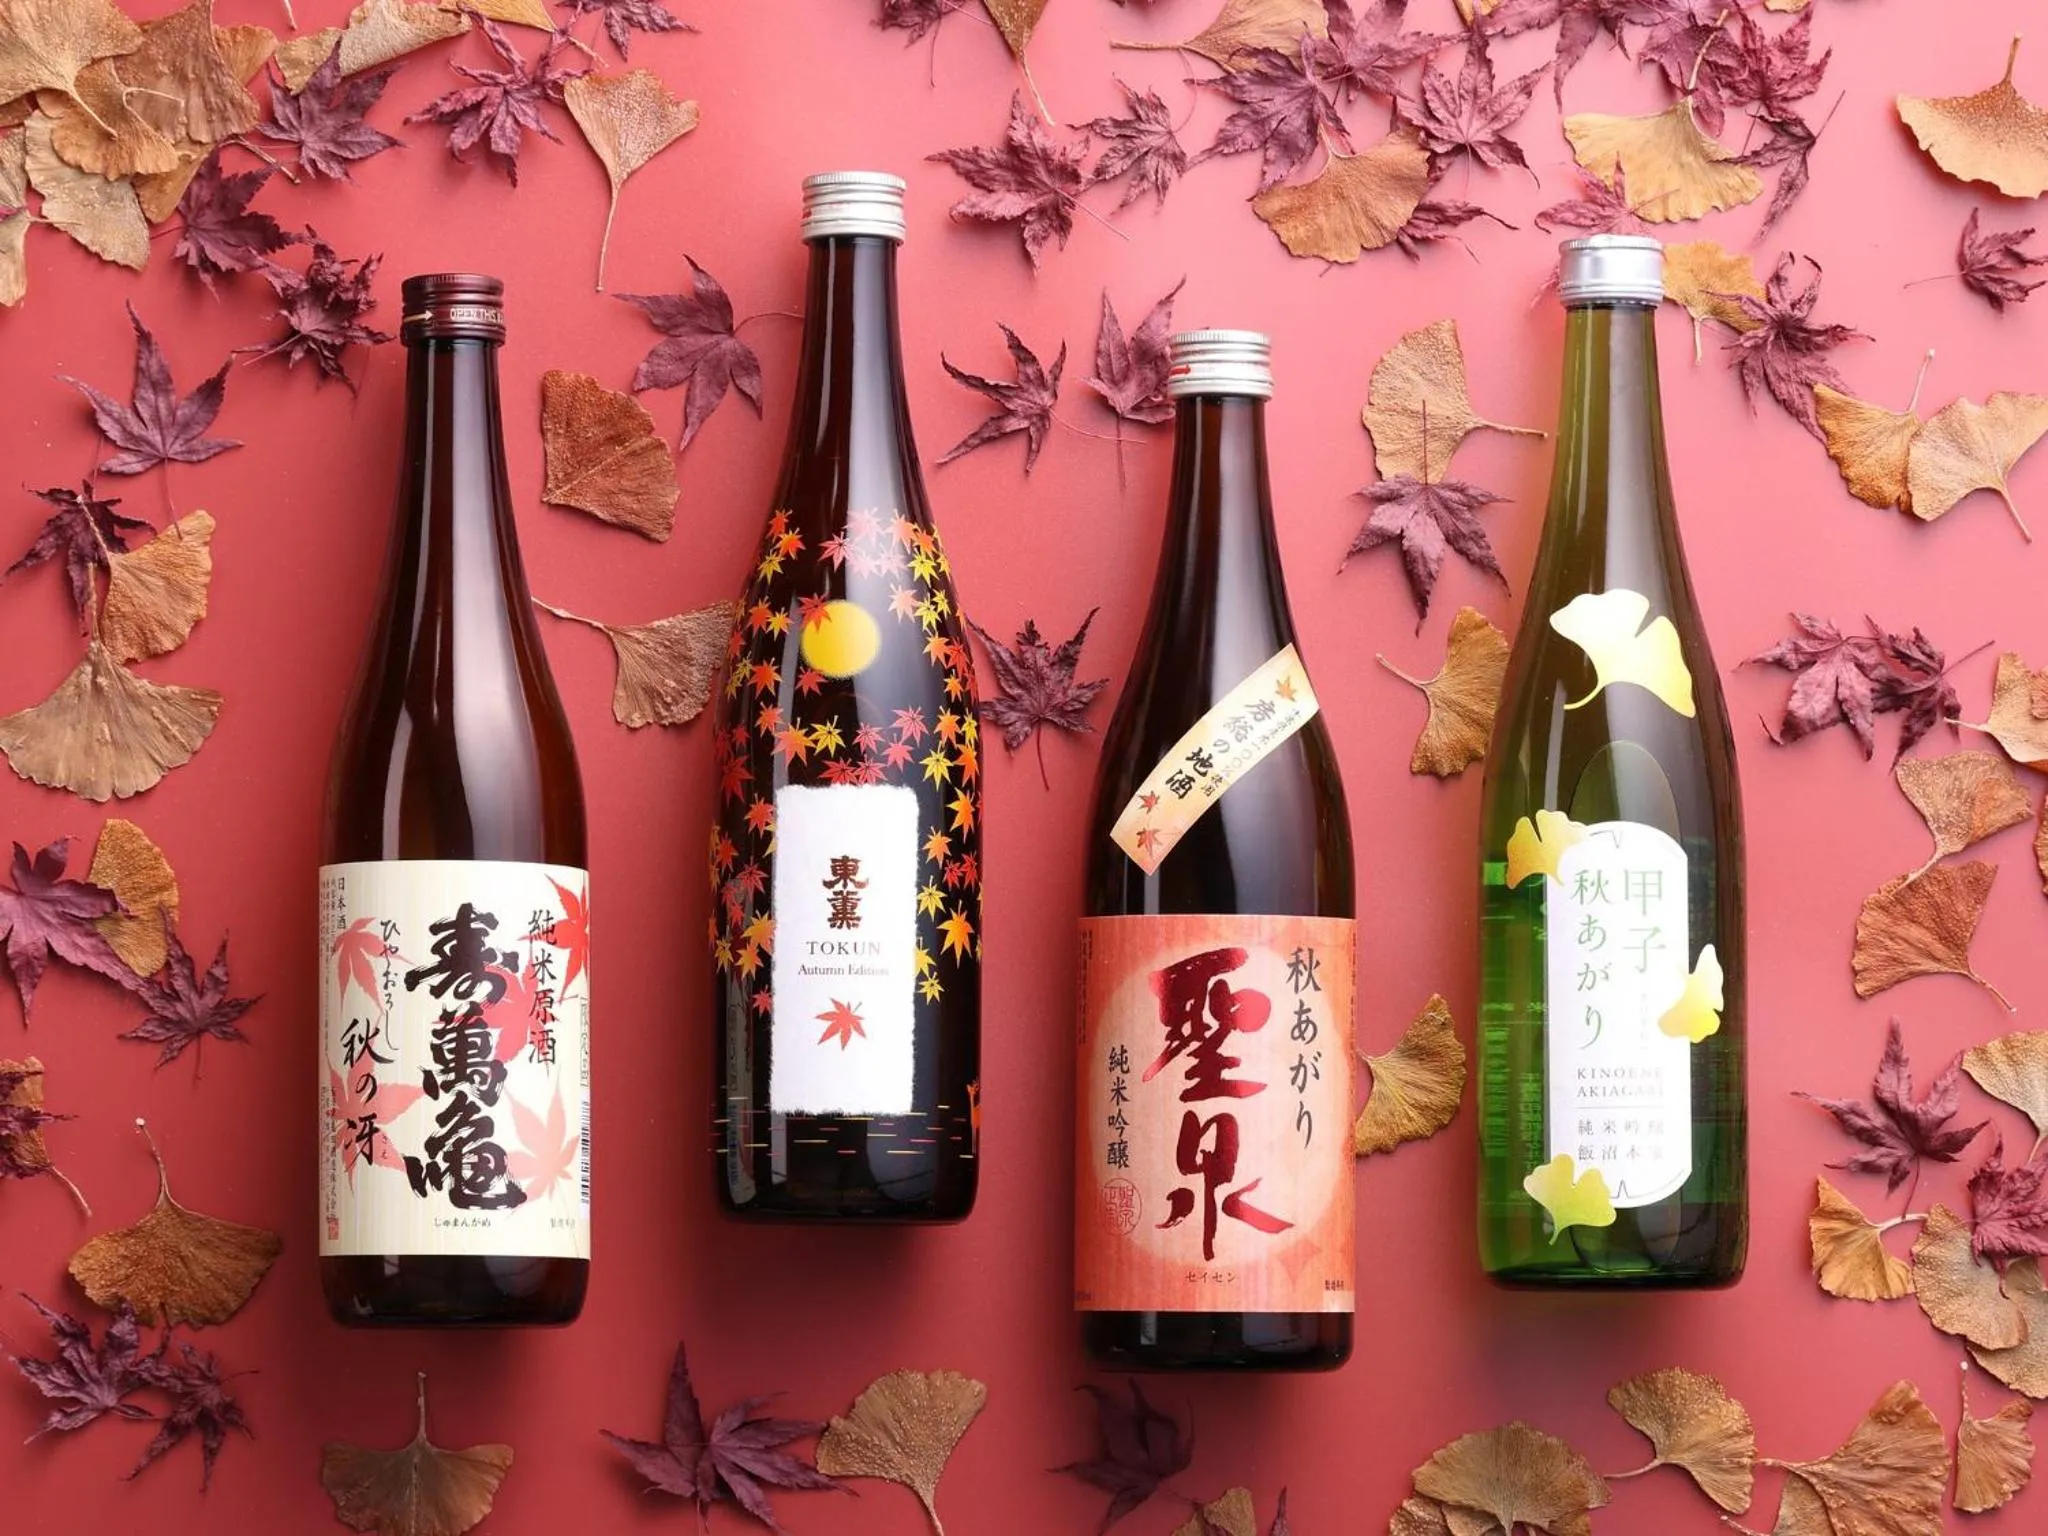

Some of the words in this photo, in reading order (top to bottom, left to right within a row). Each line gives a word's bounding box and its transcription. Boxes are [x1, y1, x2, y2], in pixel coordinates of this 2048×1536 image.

[337, 877, 346, 929] 日本酒
[805, 941, 882, 956] TOKUN
[822, 855, 869, 930] 東薫
[1623, 869, 1666, 974] 甲子
[379, 919, 401, 1051] ひやおろし
[527, 908, 557, 1066] 純米原酒
[797, 964, 845, 976] Autumn
[1570, 868, 1611, 1050] 秋あがり
[339, 1018, 394, 1167] 秋の冴
[1141, 946, 1295, 1262] 聖泉
[1286, 946, 1323, 1149] 秋あがり
[1577, 1066, 1664, 1079] KINOENE
[1106, 1044, 1130, 1169] 純米吟醸
[1184, 1271, 1236, 1284] セイセン
